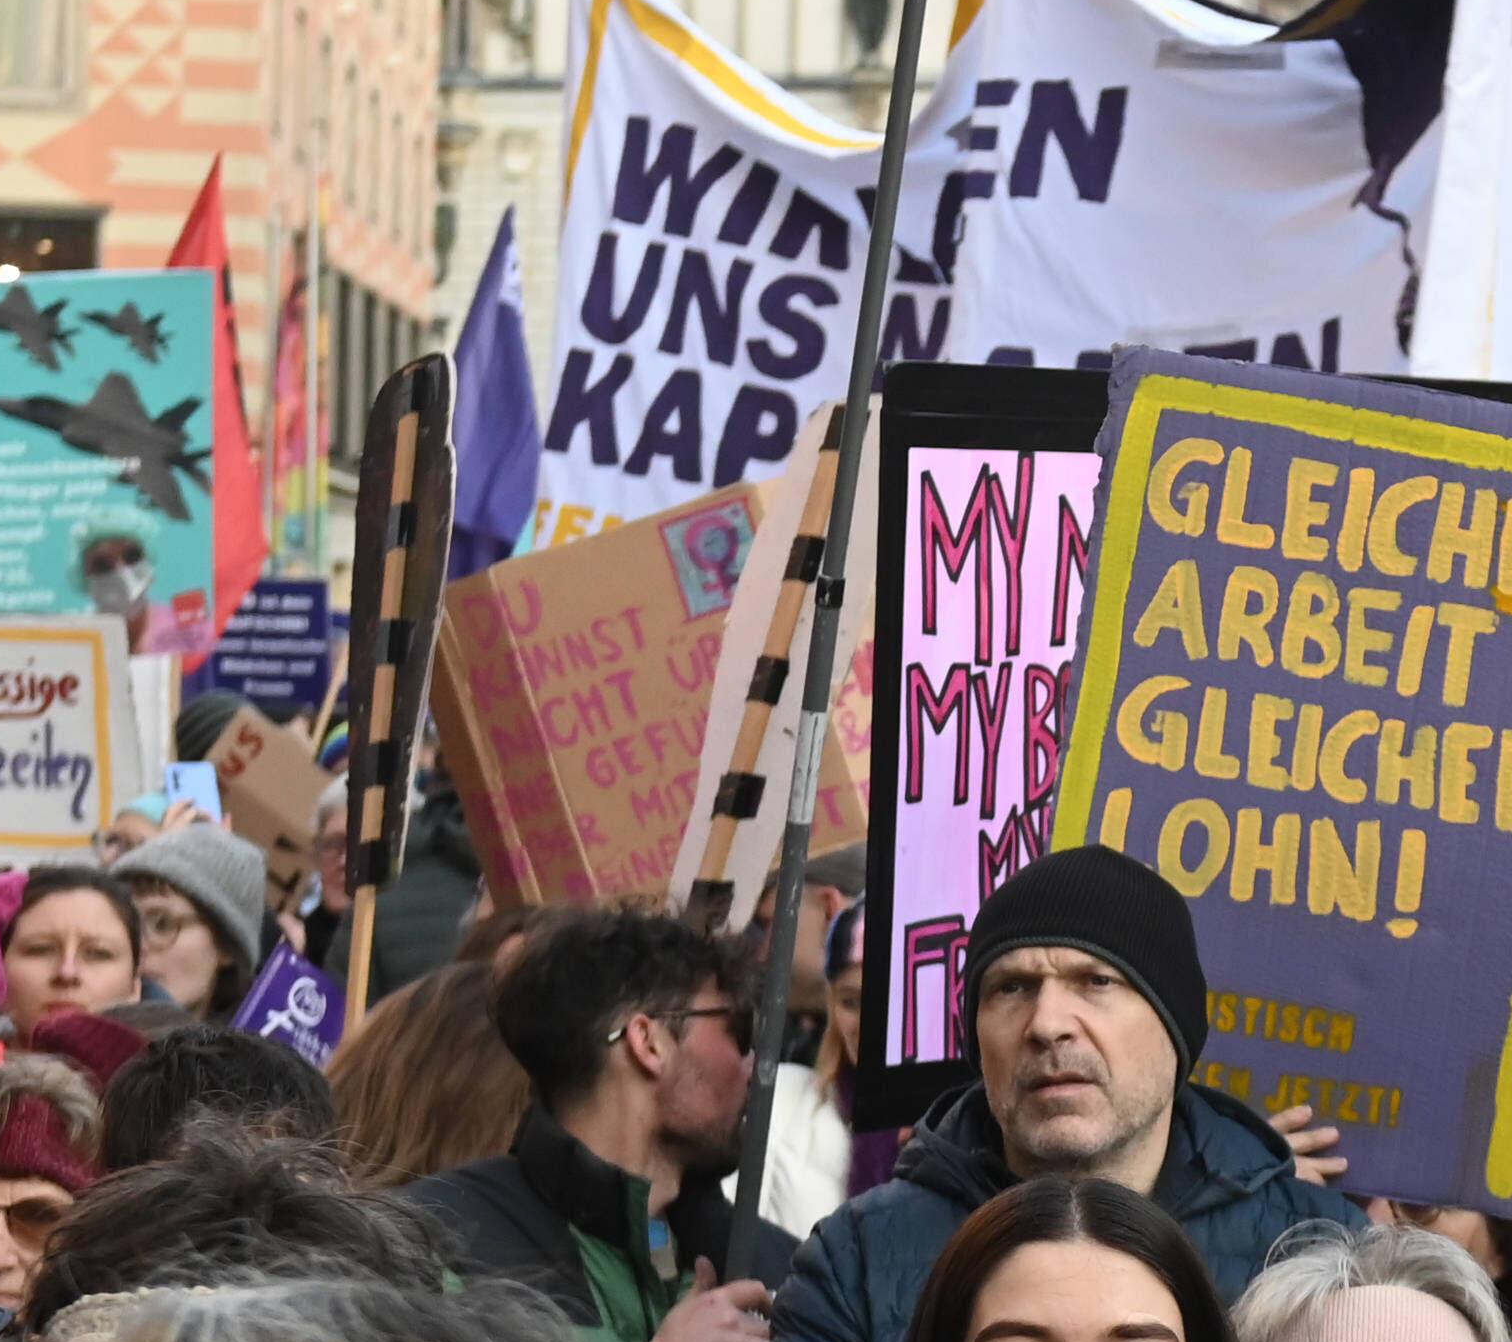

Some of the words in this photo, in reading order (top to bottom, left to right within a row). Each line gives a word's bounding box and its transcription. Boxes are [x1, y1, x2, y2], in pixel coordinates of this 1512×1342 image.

[581, 230, 841, 381] UNS
[921, 451, 1035, 667] MY
[1132, 558, 1496, 708] ARBEIT
[905, 661, 1012, 819] MY
[1099, 789, 1429, 939] LOHN!
